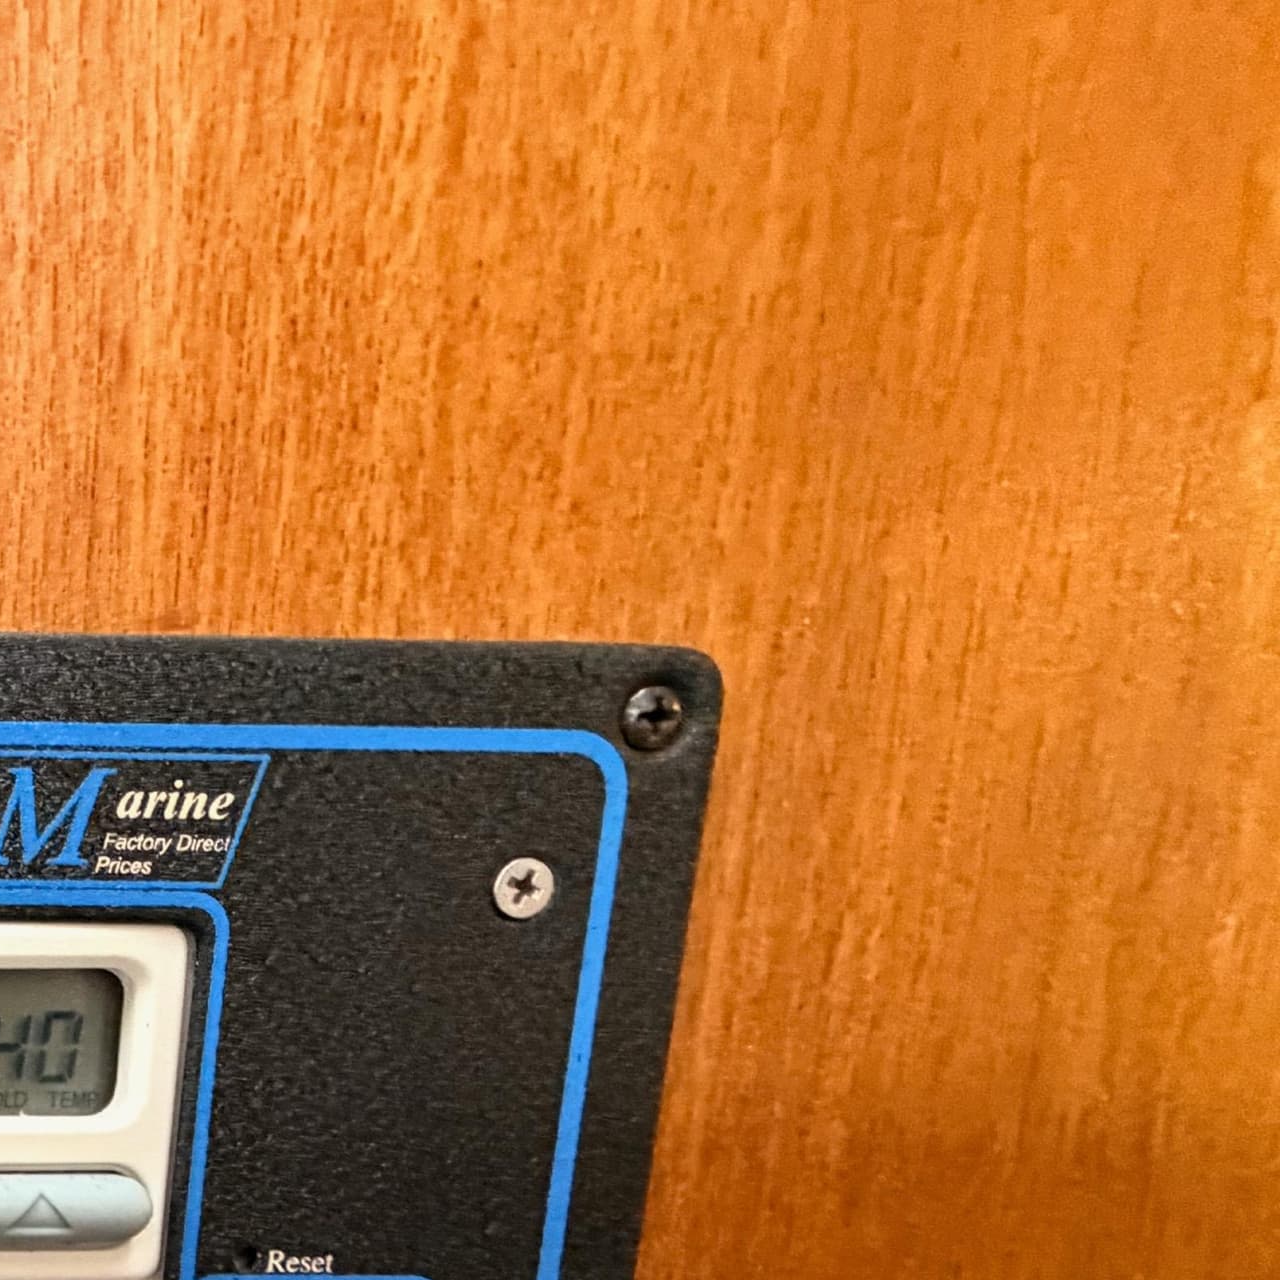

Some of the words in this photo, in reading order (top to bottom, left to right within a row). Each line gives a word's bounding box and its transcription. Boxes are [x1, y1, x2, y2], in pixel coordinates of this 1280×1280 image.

[102, 832, 172, 855] Factory
[176, 834, 230, 852] Direct
[95, 856, 152, 875] Prices
[47, 1090, 100, 1109] TEMP
[266, 1250, 334, 1273] Reset
